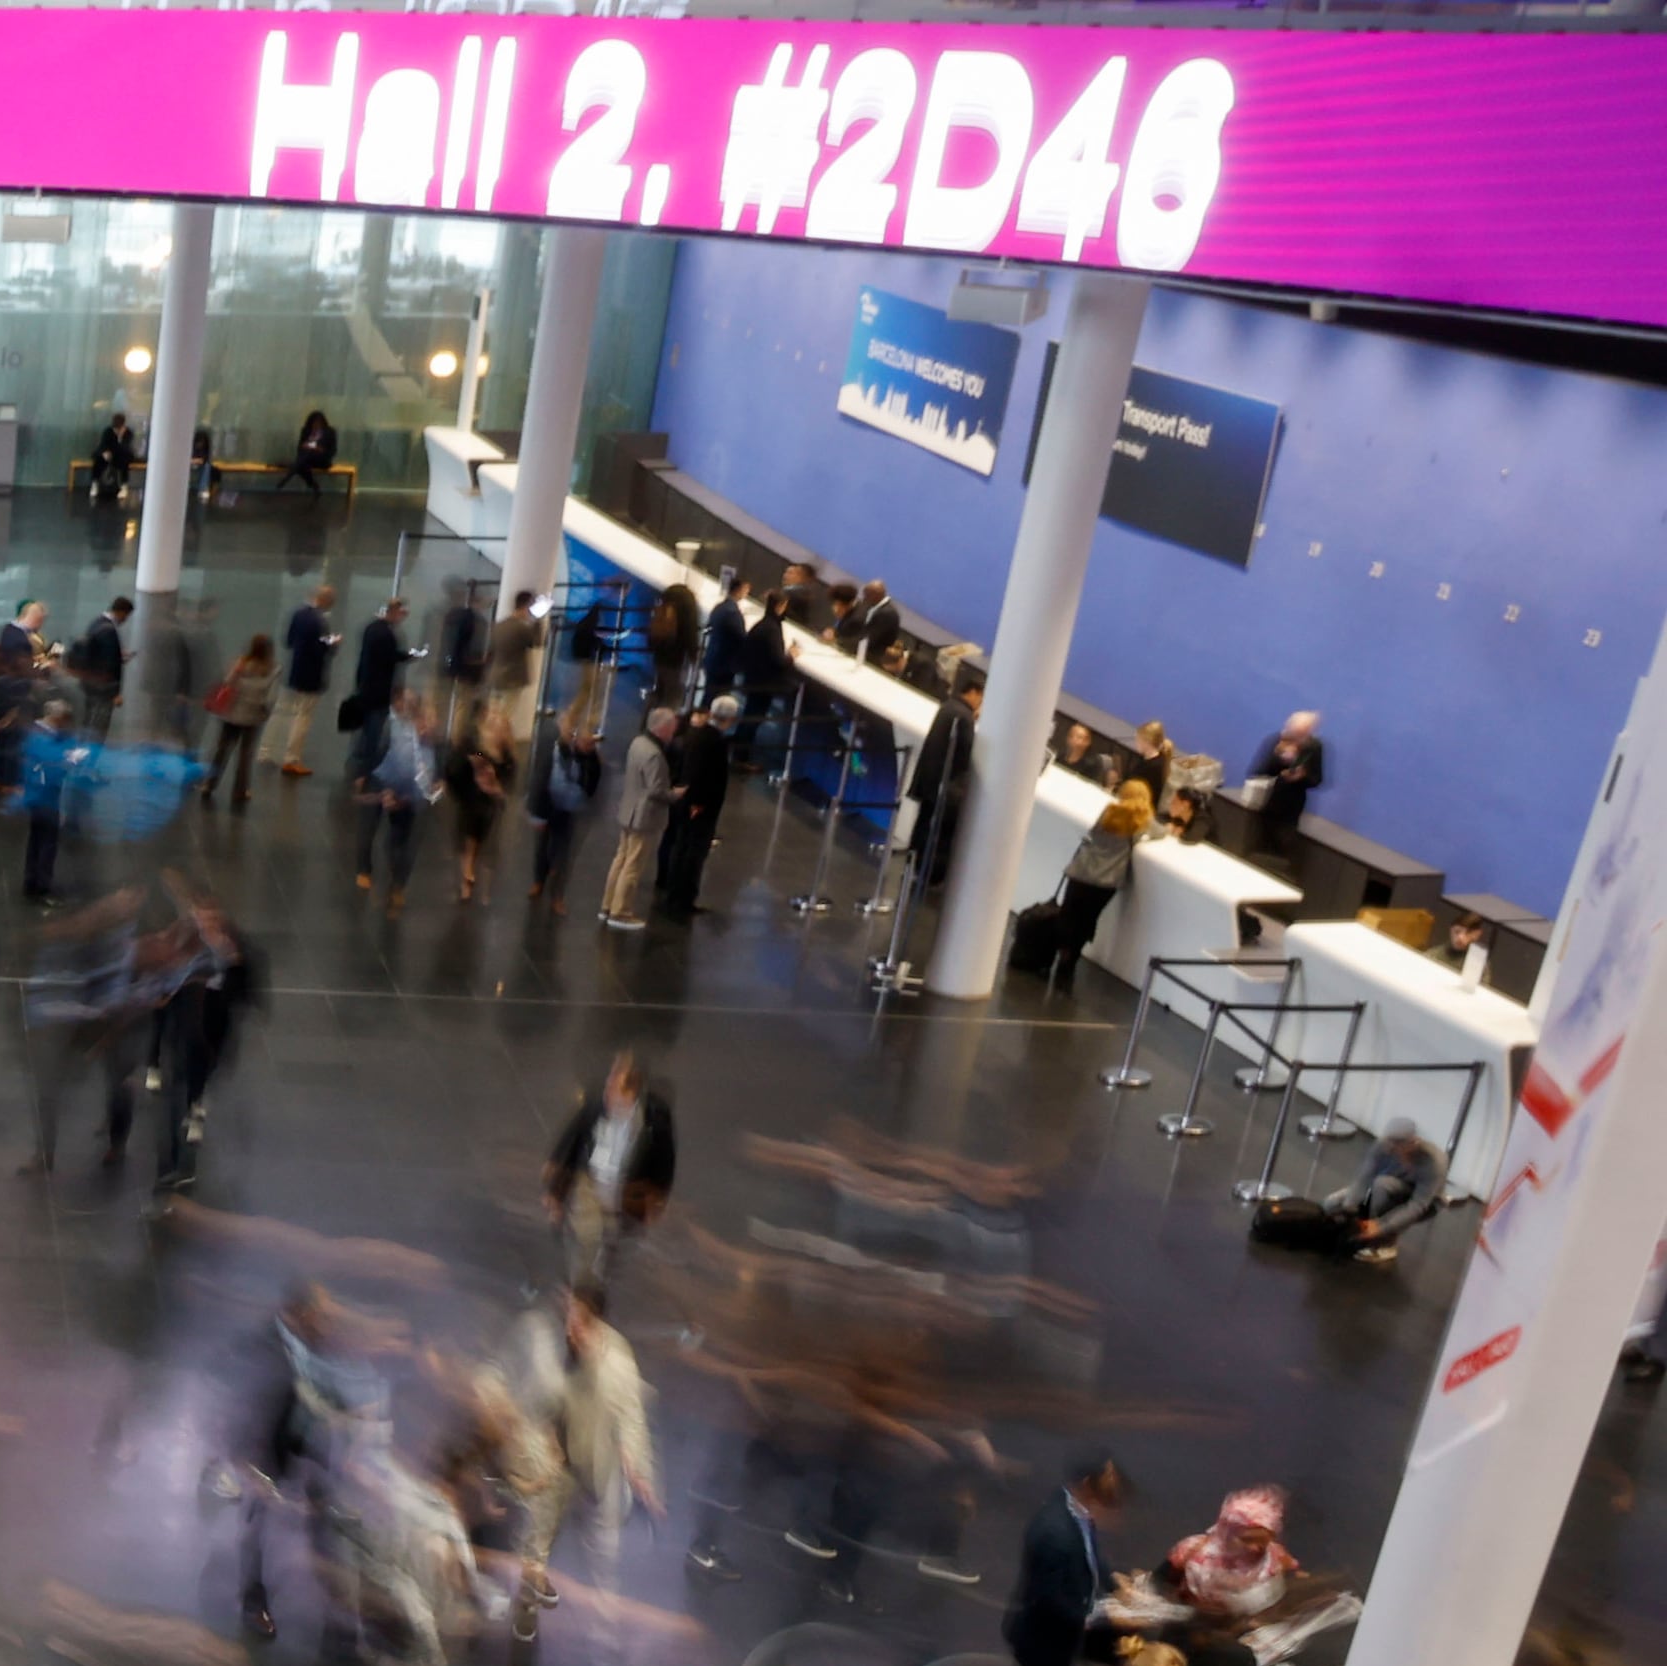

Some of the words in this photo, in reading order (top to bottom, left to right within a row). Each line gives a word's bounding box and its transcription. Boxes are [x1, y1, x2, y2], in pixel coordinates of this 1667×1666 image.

[250, 30, 517, 211] Hall
[547, 40, 670, 226] 2,
[720, 43, 1235, 271] #2D46
[1122, 399, 1179, 439] Transport
[1177, 416, 1213, 448] Pass!
